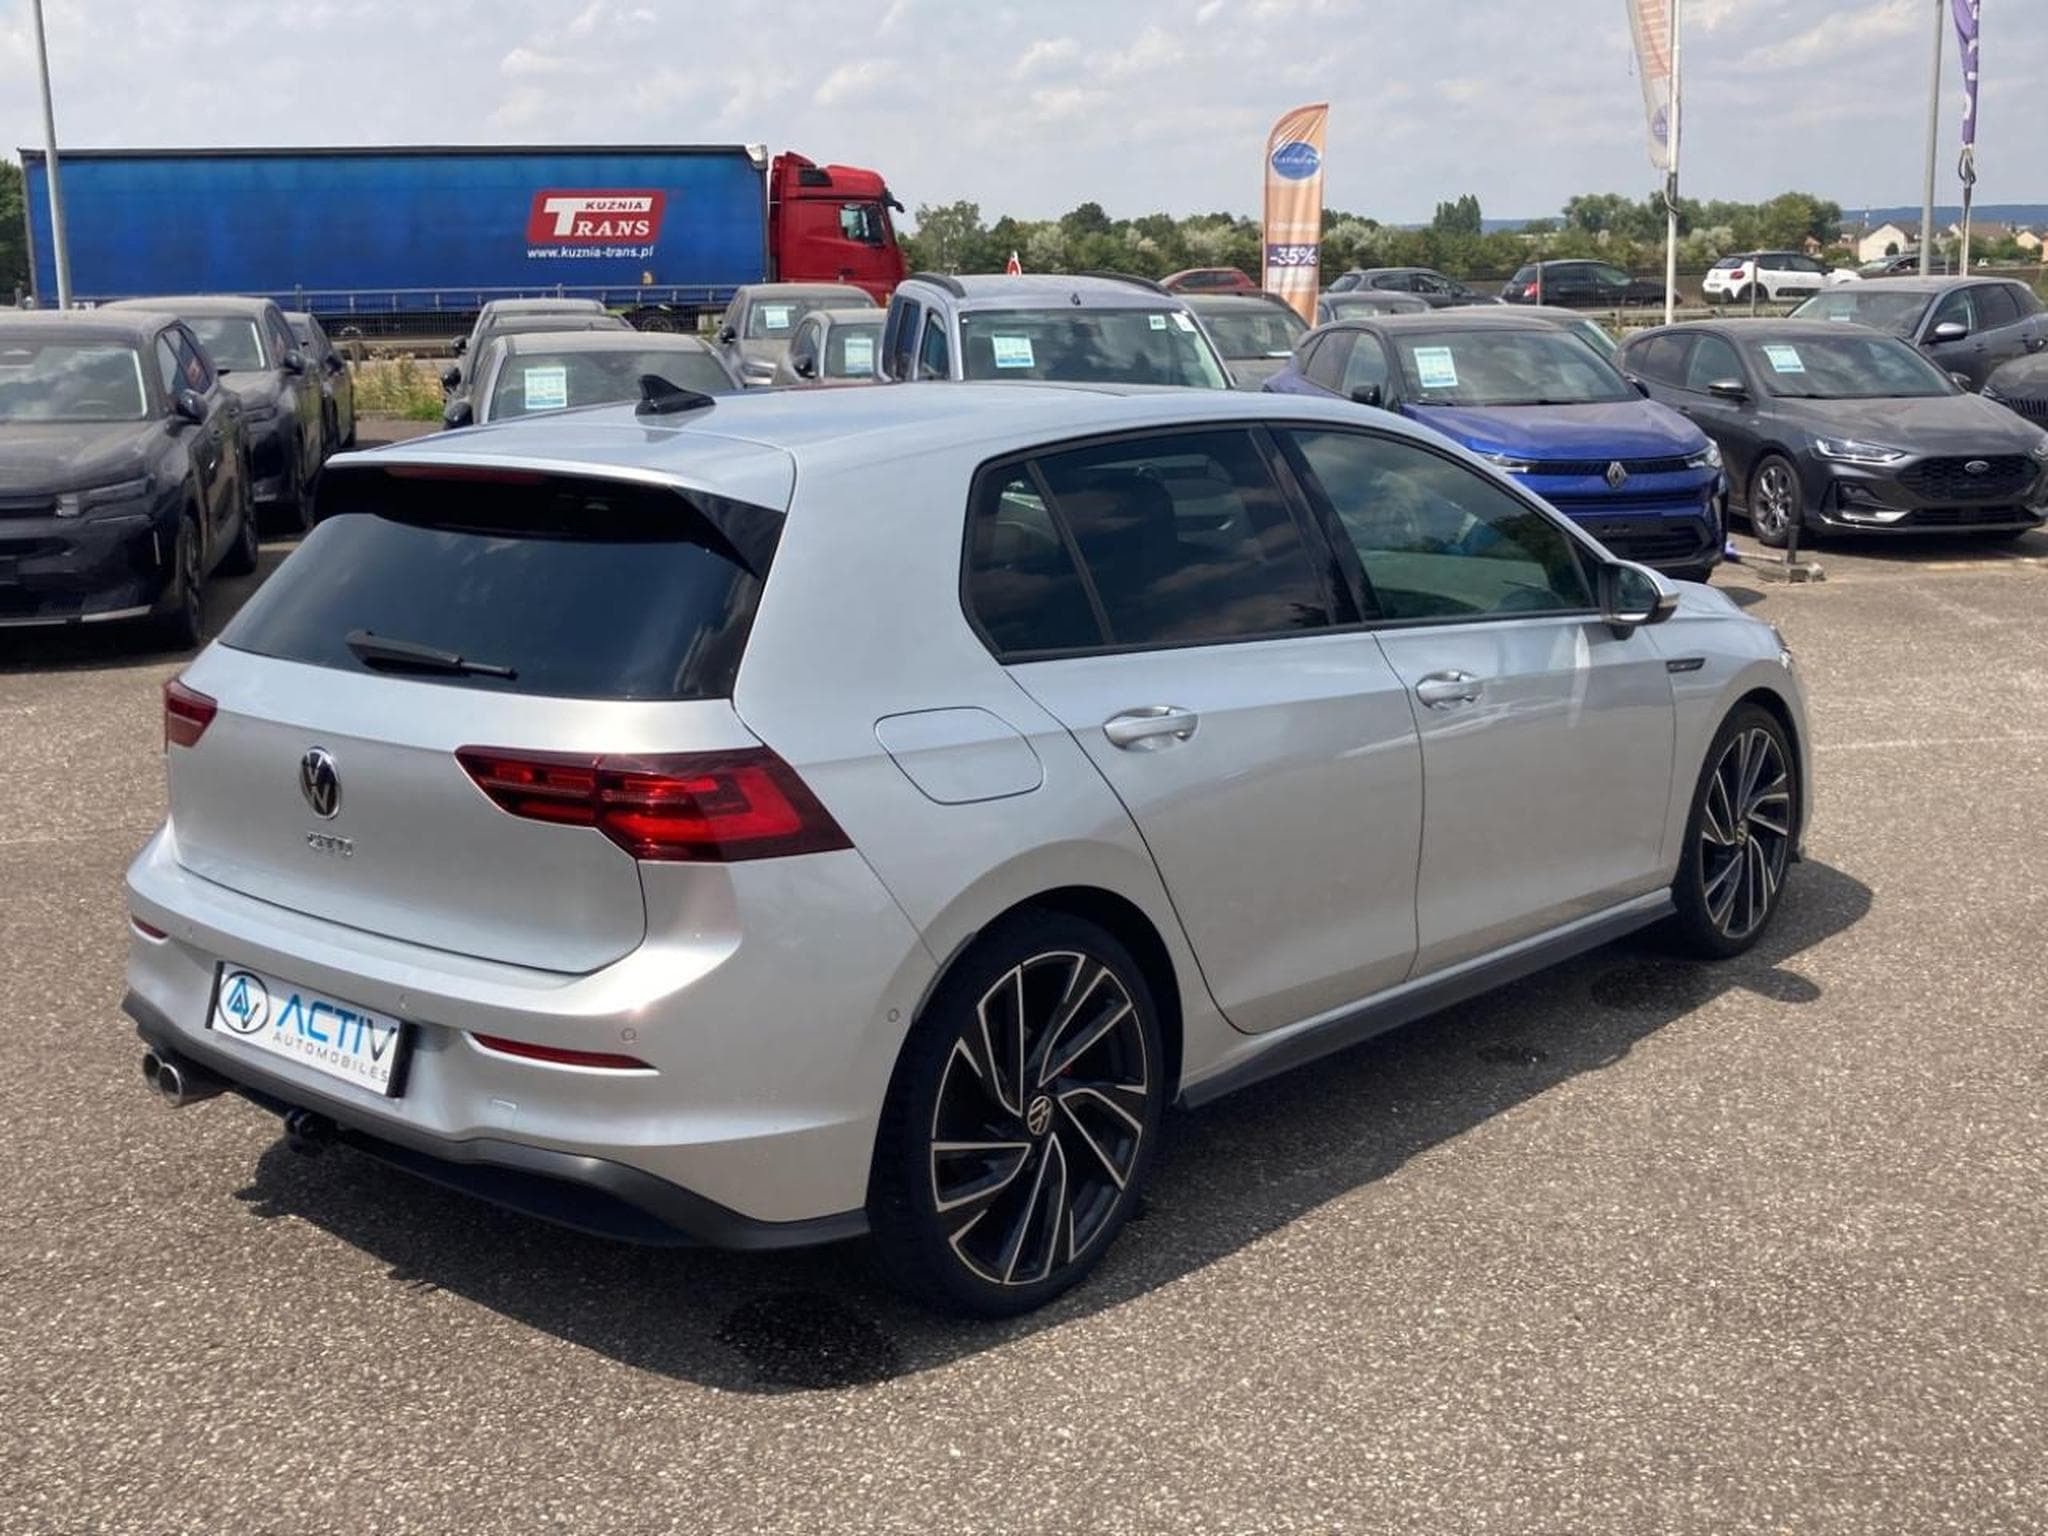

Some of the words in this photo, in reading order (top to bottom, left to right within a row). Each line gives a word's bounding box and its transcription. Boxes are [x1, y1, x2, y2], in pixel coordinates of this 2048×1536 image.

[544, 197, 652, 237] TRANS
[527, 245, 654, 259] www.kuznia-trans.pl
[1269, 246, 1318, 265] -35%
[276, 993, 397, 1062] ACTIV
[273, 1033, 388, 1082] AUTOMOBILES
